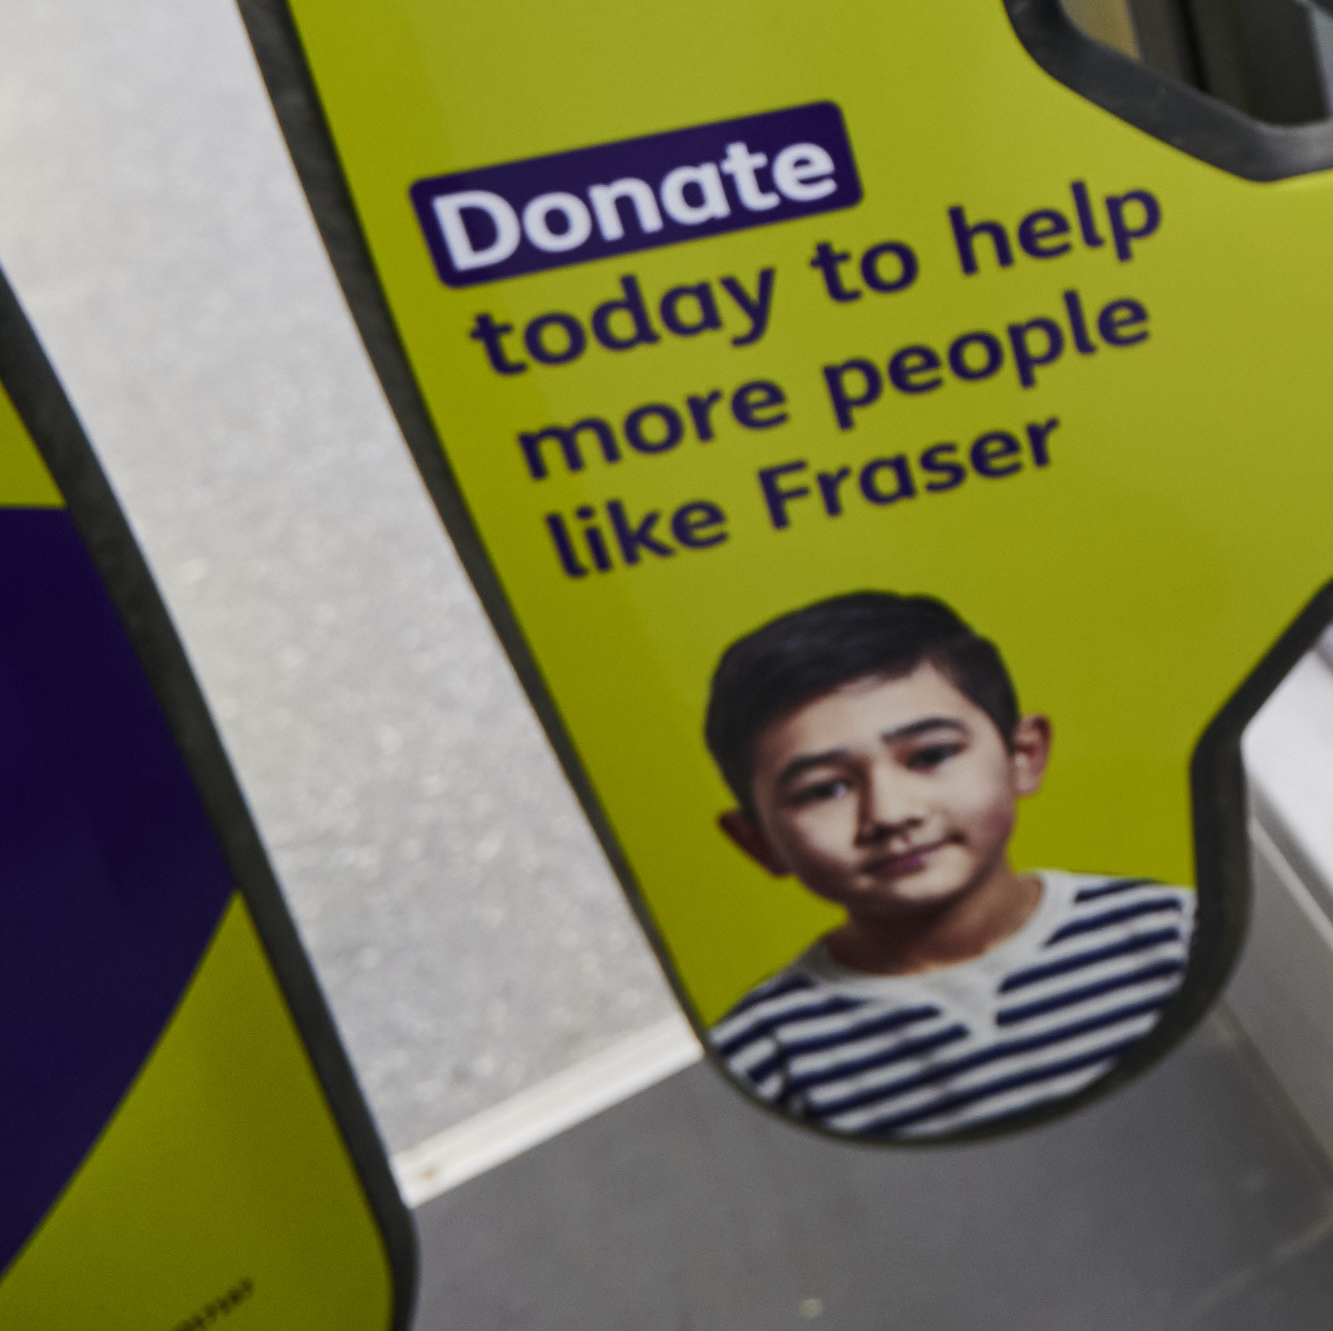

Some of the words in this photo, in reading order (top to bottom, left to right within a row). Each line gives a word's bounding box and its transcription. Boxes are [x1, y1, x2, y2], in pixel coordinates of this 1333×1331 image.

[431, 141, 840, 272] Donate
[468, 273, 776, 376] today
[809, 241, 919, 303] to
[948, 180, 1163, 276] help
[517, 378, 790, 481] more
[822, 289, 1150, 431] people
[545, 500, 729, 578] like
[758, 417, 1060, 530] Fraser
